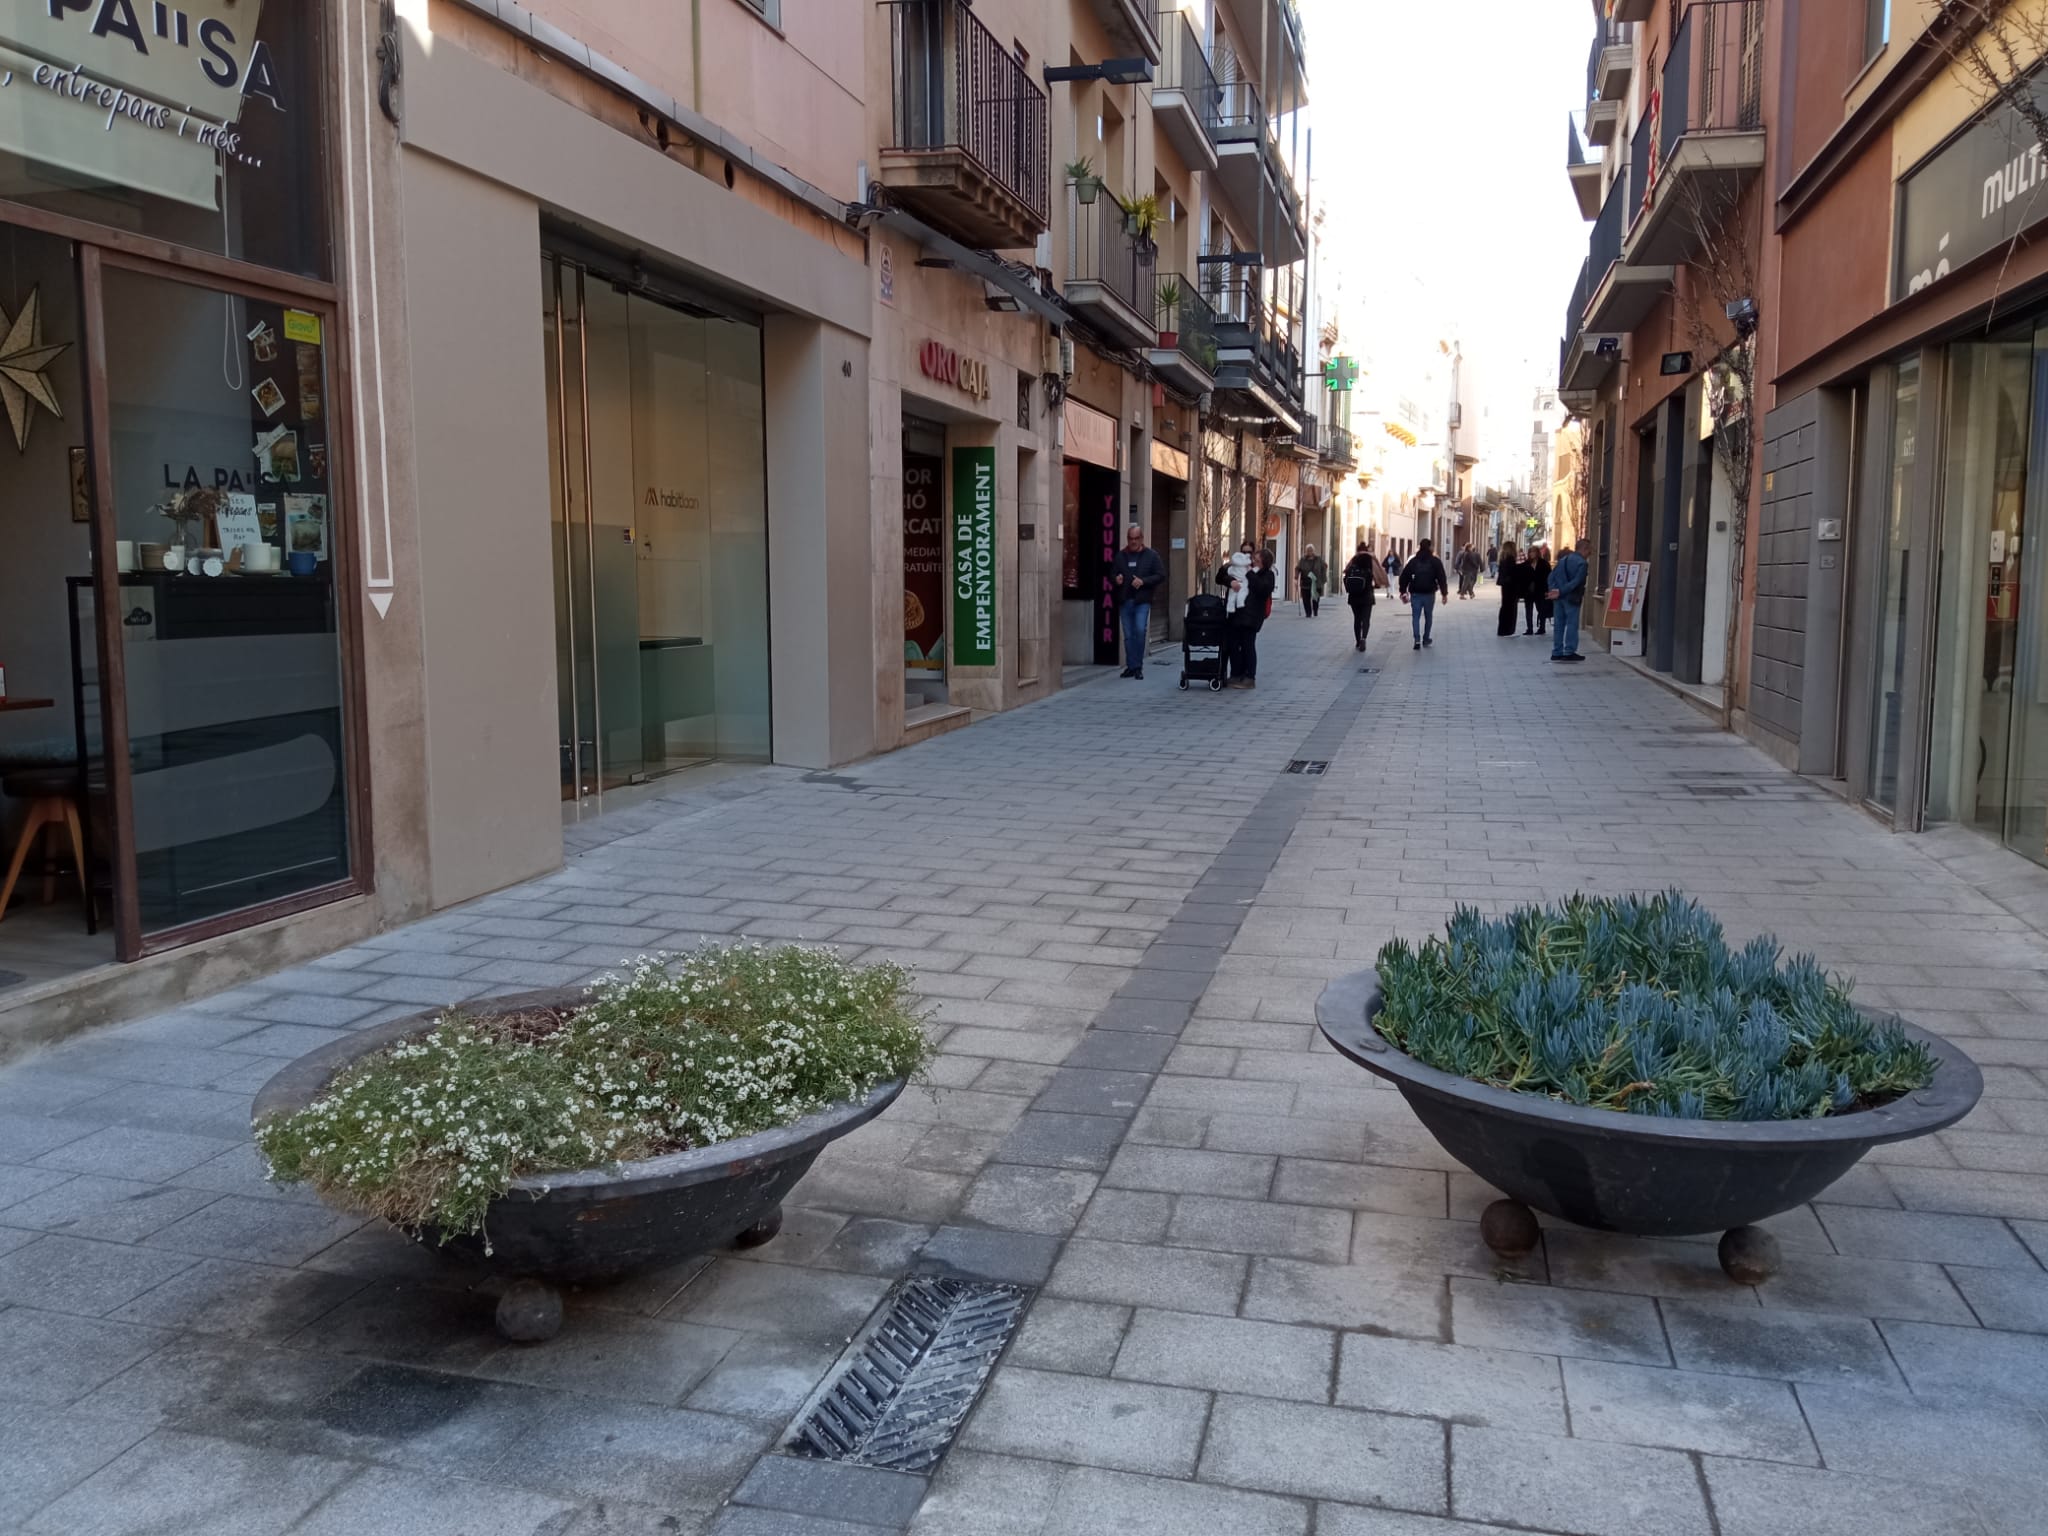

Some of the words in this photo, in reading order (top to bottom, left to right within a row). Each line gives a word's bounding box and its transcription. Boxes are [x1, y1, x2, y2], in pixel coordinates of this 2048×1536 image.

[33, 63, 171, 131] entrepans
[178, 106, 192, 136] i
[164, 464, 201, 489] LA
[904, 489, 927, 510] IÓ
[958, 514, 973, 541] DE
[1103, 495, 1115, 563] YOUR
[958, 547, 973, 600] CASA
[976, 463, 991, 650] EMPENYORAMENT
